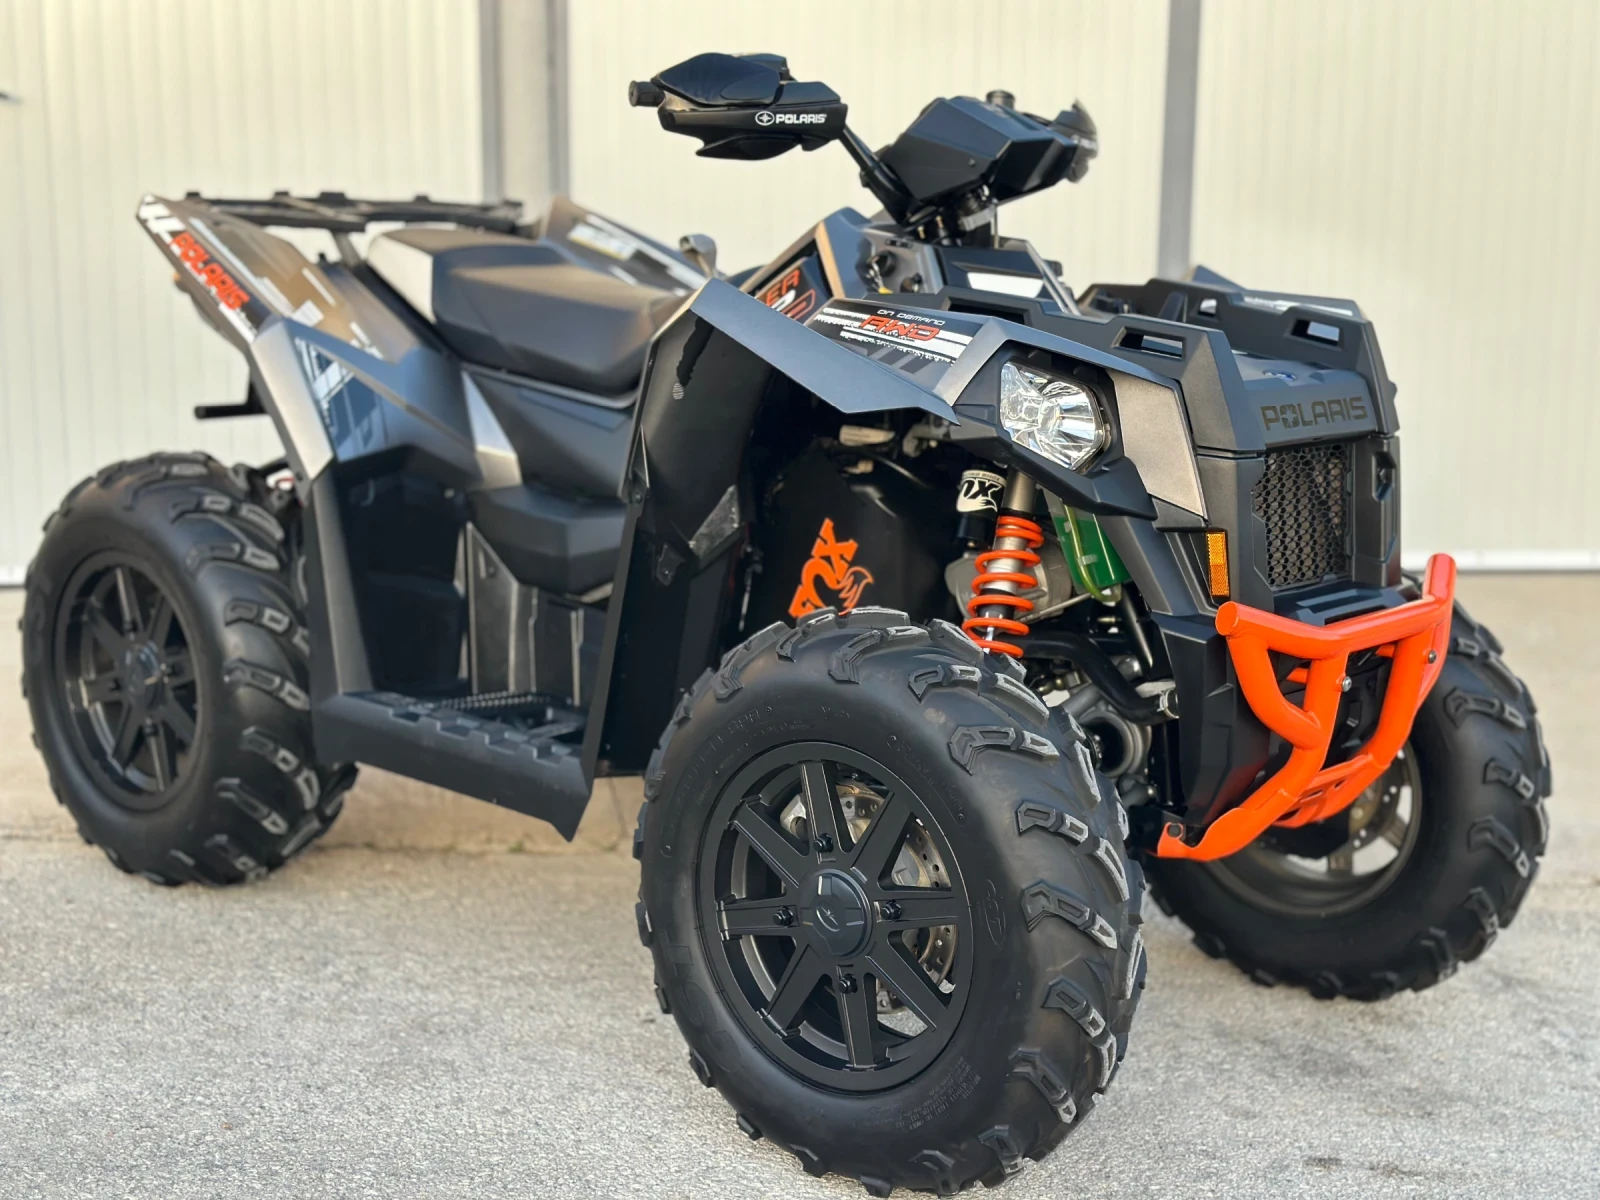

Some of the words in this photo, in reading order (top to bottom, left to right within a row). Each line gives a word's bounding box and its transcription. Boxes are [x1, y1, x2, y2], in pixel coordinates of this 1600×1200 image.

[775, 113, 826, 125] POLARIS
[169, 231, 250, 311] POLARIS
[859, 314, 941, 342] AWD
[877, 309, 895, 317] ON
[896, 312, 946, 326] DEMAND
[1260, 395, 1368, 432] POLARIS
